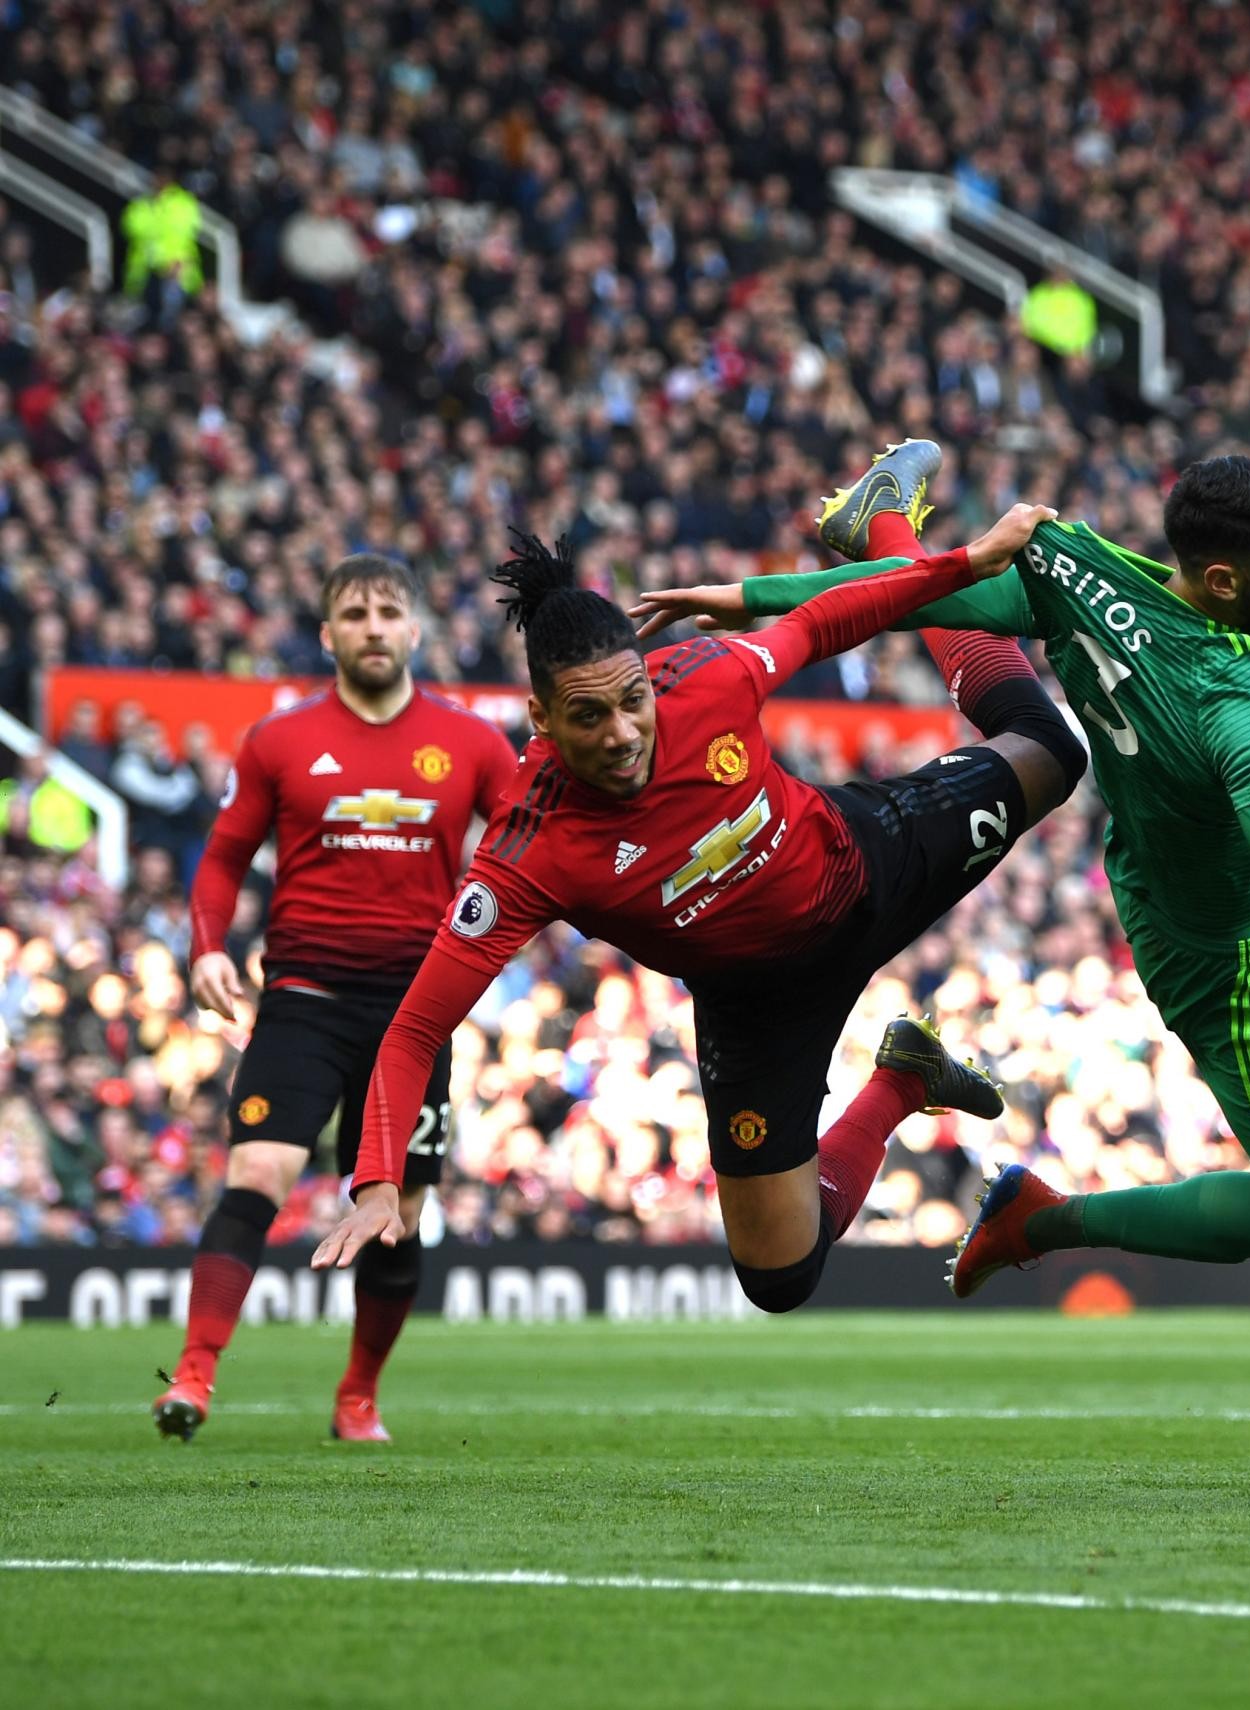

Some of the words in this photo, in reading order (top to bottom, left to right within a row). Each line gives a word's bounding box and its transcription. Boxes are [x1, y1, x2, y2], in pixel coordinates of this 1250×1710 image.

[1024, 543, 1152, 652] BRITOS
[321, 833, 435, 853] CHEVROLET
[614, 845, 647, 874] adidas
[674, 817, 787, 928] CHEROLET
